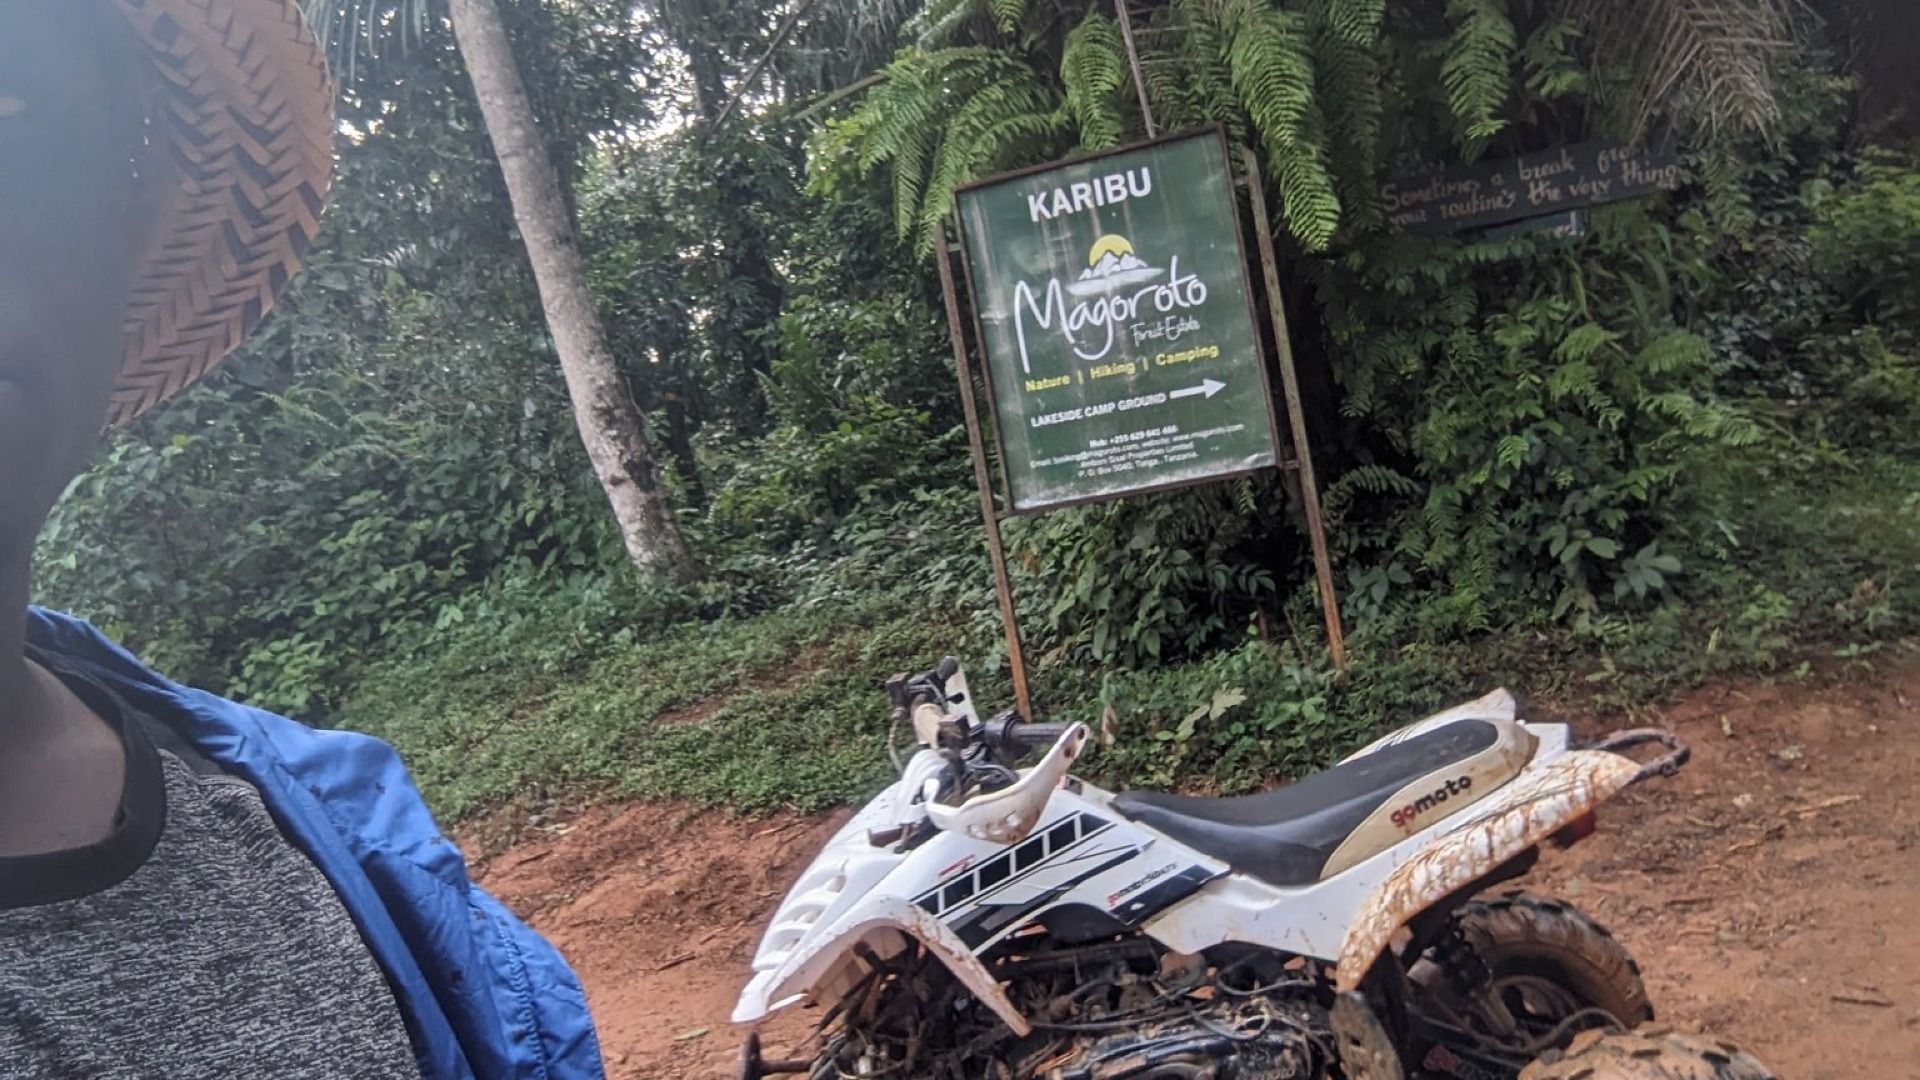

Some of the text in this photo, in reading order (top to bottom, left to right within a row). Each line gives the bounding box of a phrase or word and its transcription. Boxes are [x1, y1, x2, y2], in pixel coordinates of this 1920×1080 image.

[1490, 173, 1504, 186] a
[1517, 148, 1575, 181] break
[1027, 166, 1152, 222] KARIBU
[1440, 188, 1516, 219] routine's
[1528, 179, 1561, 205] the
[1568, 175, 1611, 201] very
[1013, 254, 1207, 374] Magoroto
[1025, 373, 1071, 392] Nature
[1090, 361, 1136, 380] Hiking
[1155, 344, 1220, 366] Camping
[1030, 391, 1168, 428] LAKESIDE CAMP GROUND
[1390, 775, 1472, 828] gomoto
